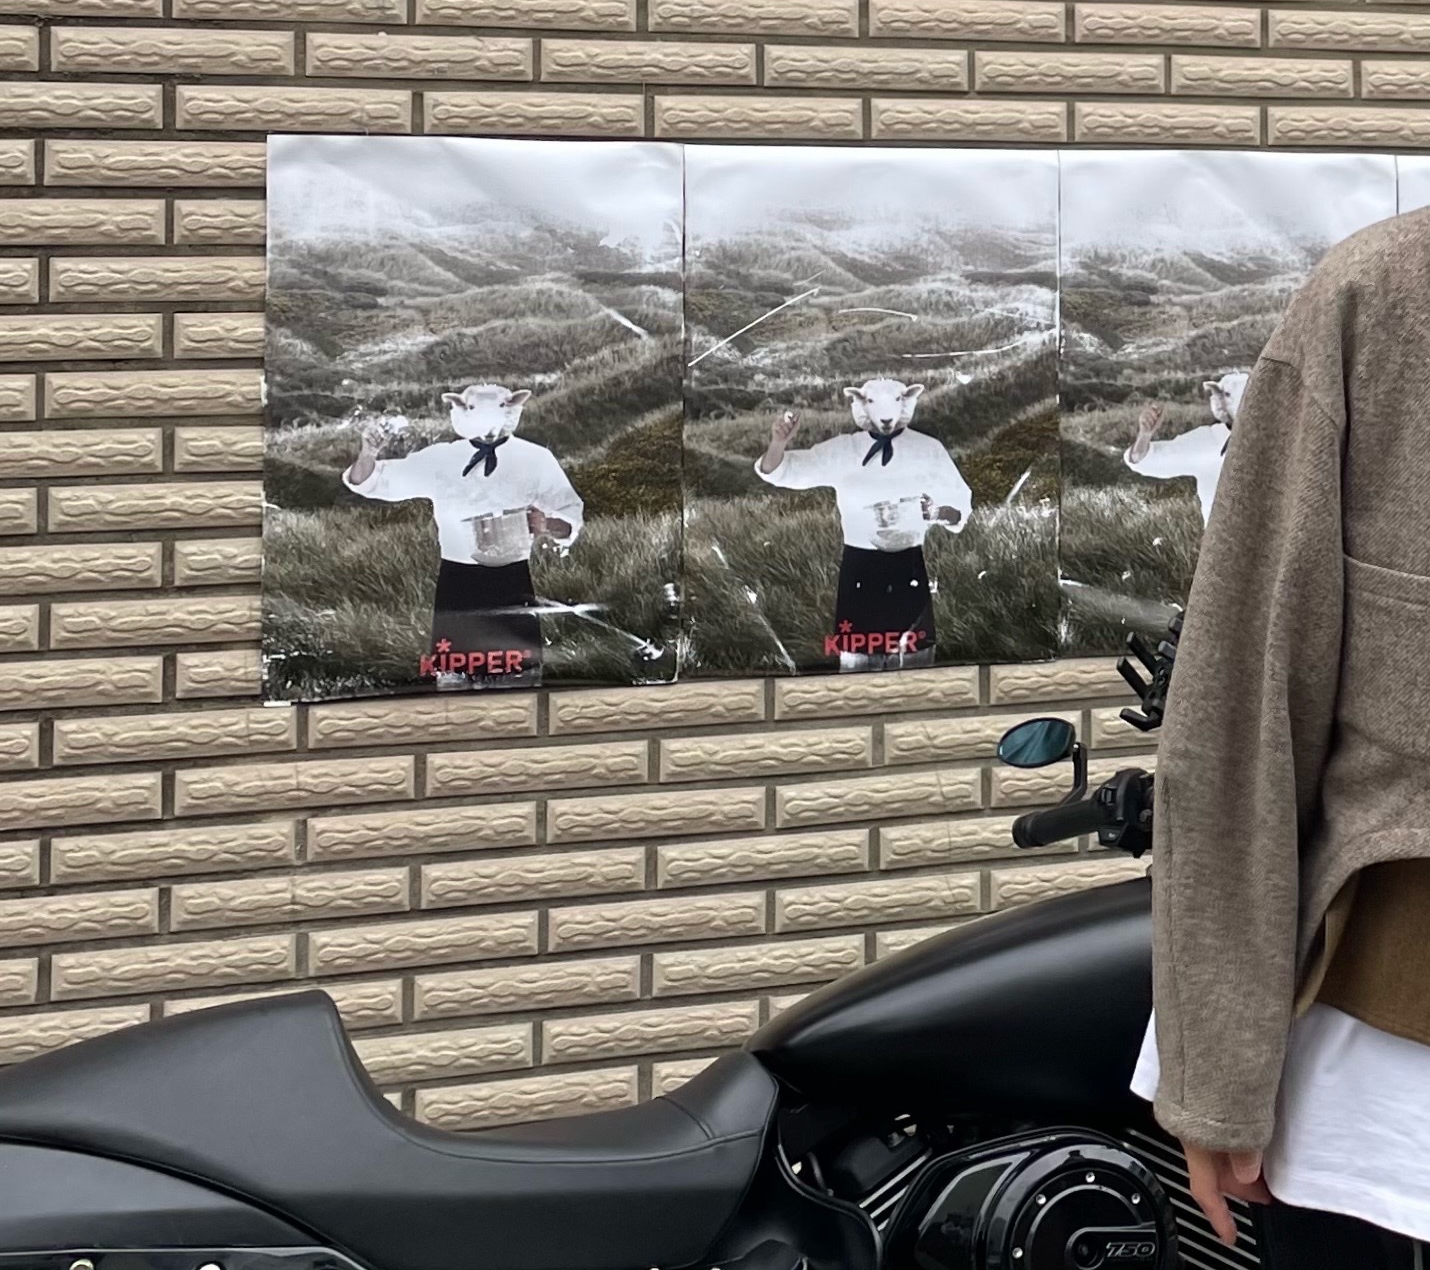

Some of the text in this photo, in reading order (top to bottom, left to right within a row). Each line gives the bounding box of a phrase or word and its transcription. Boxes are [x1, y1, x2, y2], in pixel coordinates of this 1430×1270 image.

[824, 630, 918, 656] KIPPER
[419, 649, 523, 677] KIPPER
[1105, 1241, 1156, 1258] 750
